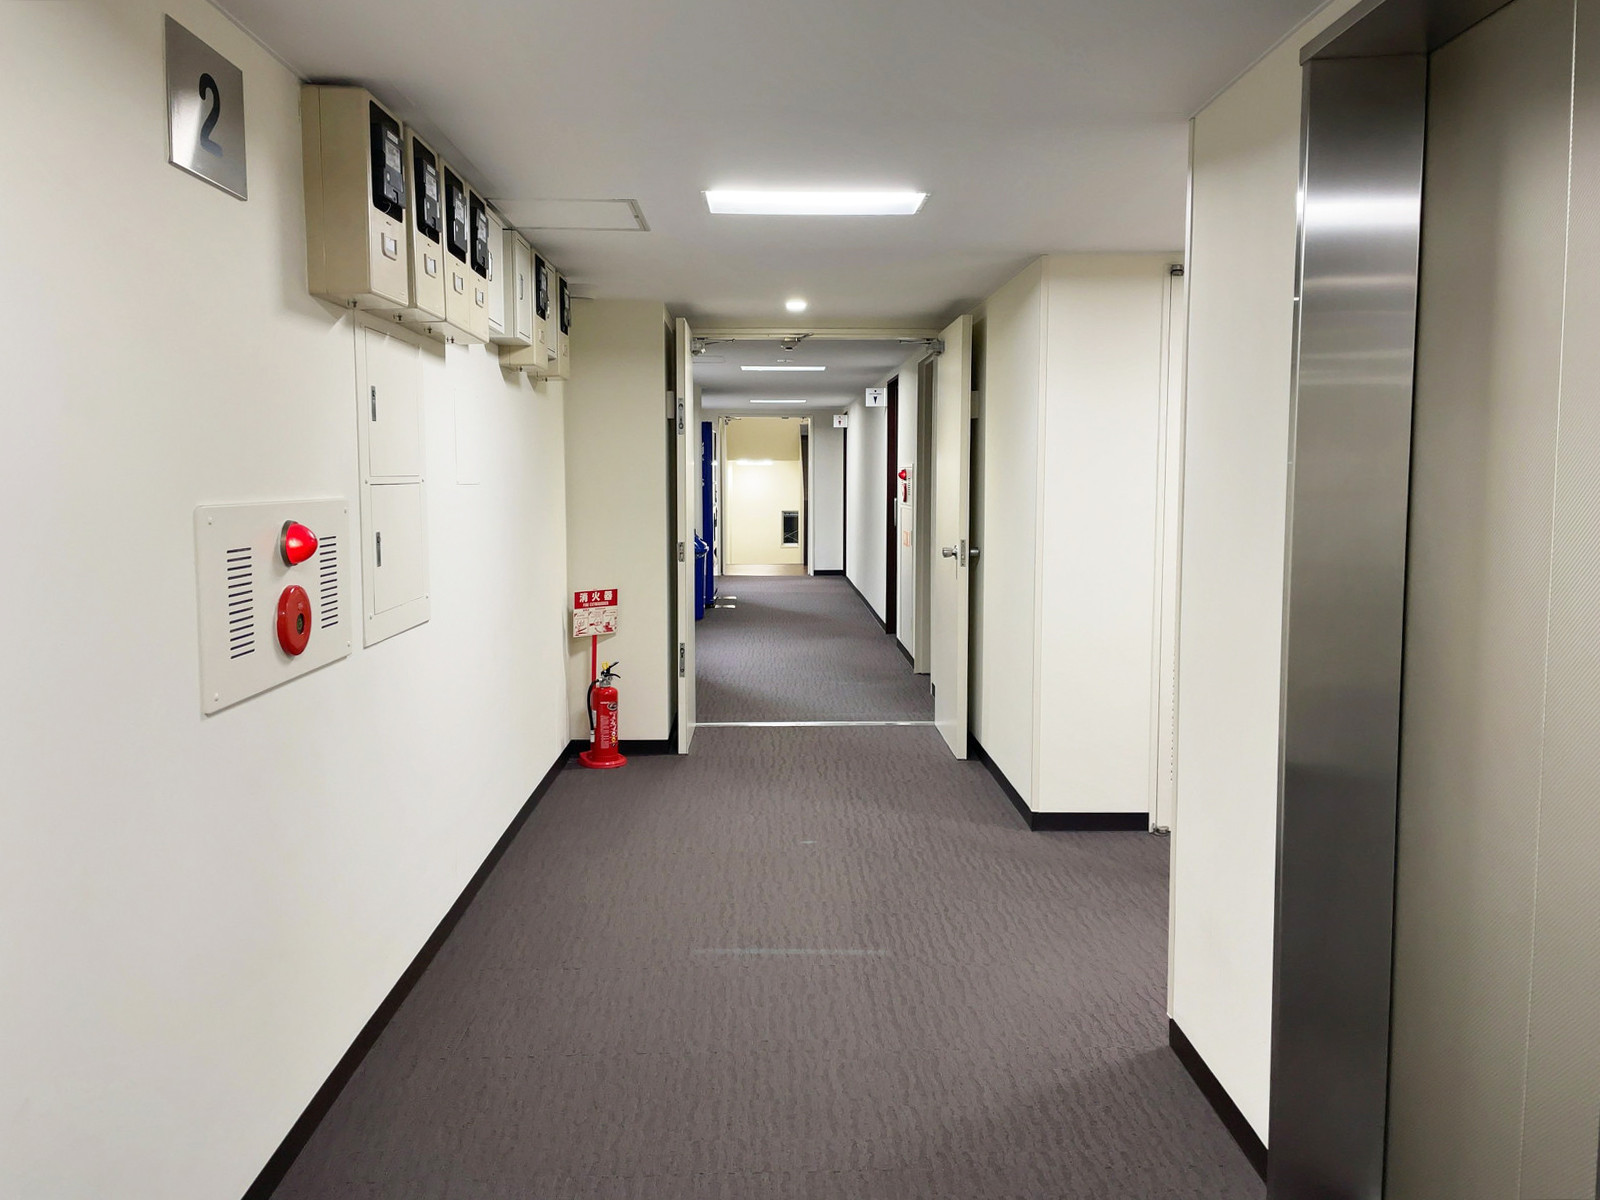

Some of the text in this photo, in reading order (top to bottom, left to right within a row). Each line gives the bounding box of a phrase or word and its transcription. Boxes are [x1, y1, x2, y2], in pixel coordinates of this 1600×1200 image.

[199, 73, 223, 158] 2
[579, 591, 612, 603] 消火器
